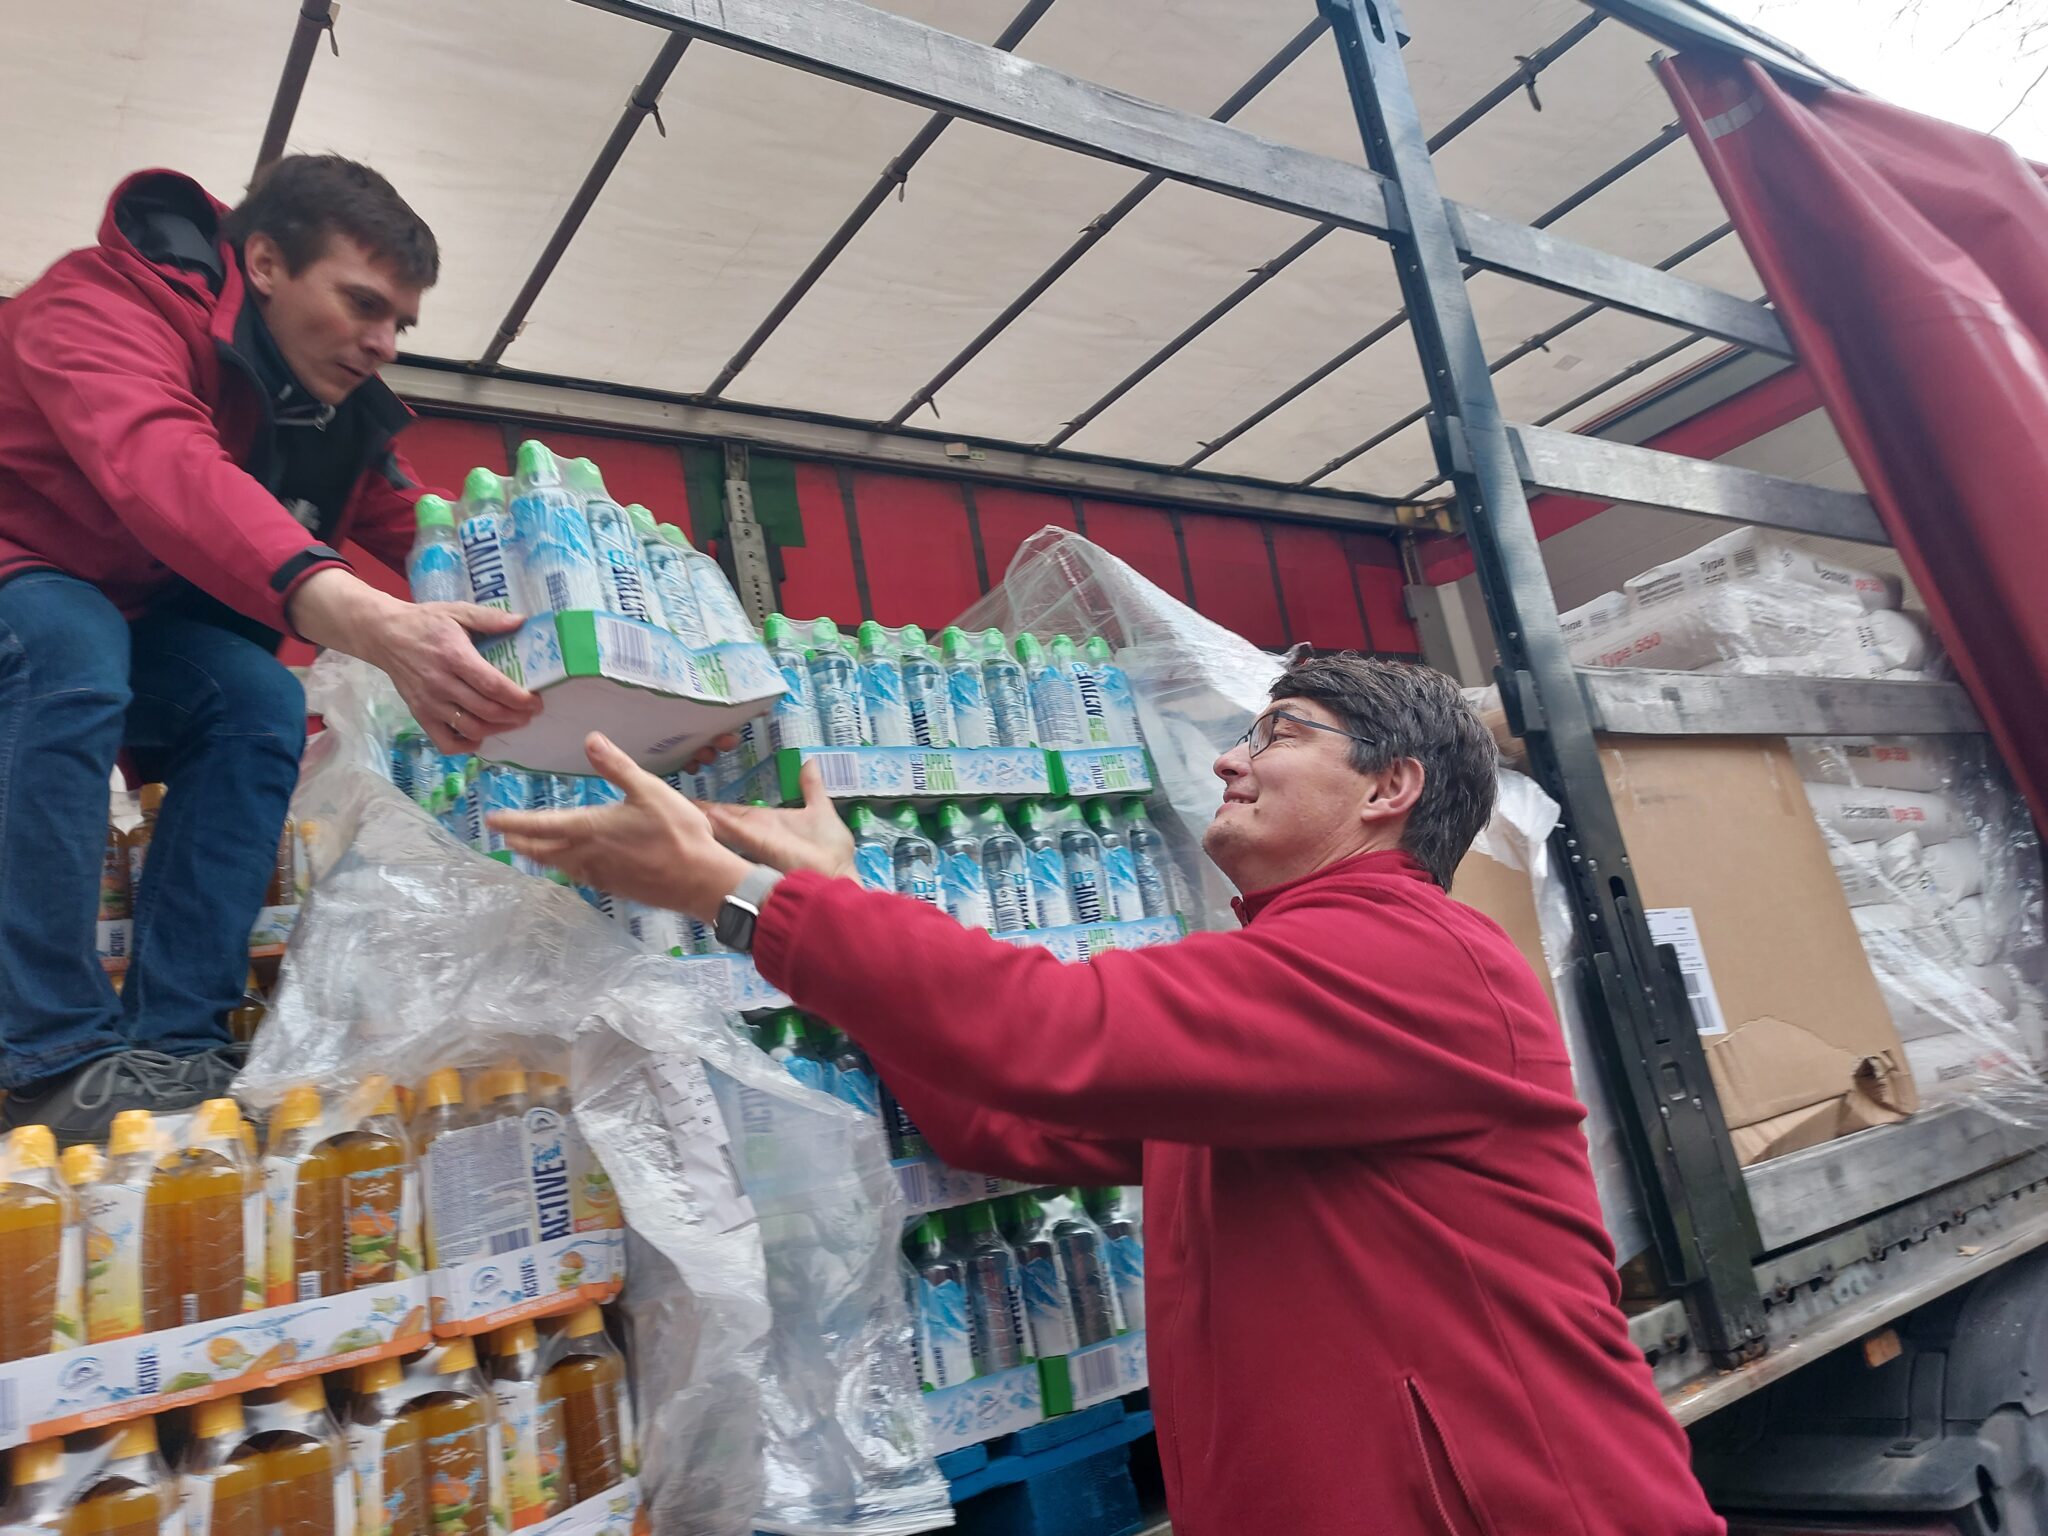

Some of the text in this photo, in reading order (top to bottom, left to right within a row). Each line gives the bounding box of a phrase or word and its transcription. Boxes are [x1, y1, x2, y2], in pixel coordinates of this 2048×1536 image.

[463, 532, 509, 603] ACTIVE
[1700, 557, 1726, 573] Type
[1600, 647, 1633, 667] Type
[1076, 672, 1105, 718] ACTIVE
[912, 710, 931, 747] CTIVE
[924, 753, 953, 771] APPLE
[1100, 753, 1126, 770] APPLE
[911, 763, 927, 790] ACTIVE
[1090, 765, 1109, 790] ACTIVE
[1088, 928, 1116, 945] APPLE
[532, 1160, 573, 1242] ACTIVE
[520, 1264, 539, 1297] ACTIVE
[136, 1355, 162, 1394] ACTIVE
